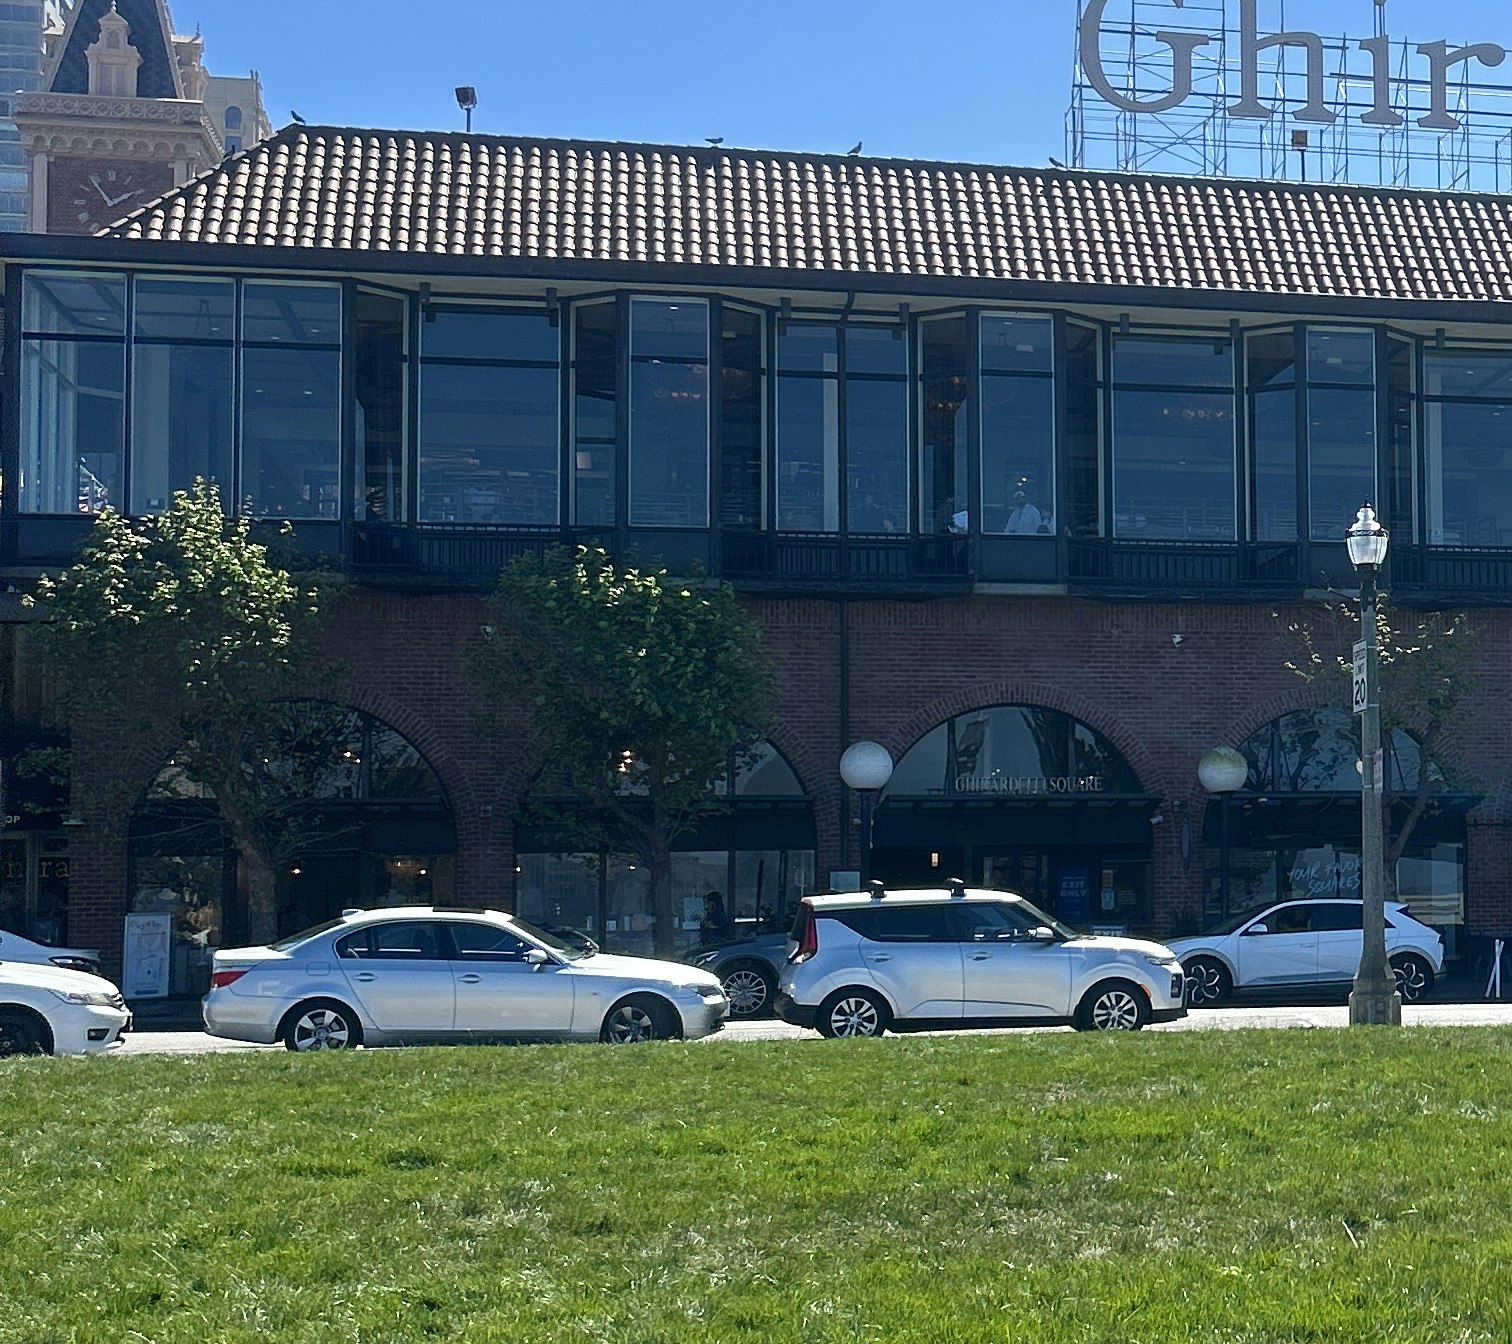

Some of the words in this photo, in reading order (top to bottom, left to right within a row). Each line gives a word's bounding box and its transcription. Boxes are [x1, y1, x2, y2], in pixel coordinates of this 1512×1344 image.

[1354, 677, 1366, 706] 20
[1049, 775, 1104, 793] SQUARE
[1324, 857, 1363, 876] FAVOR
